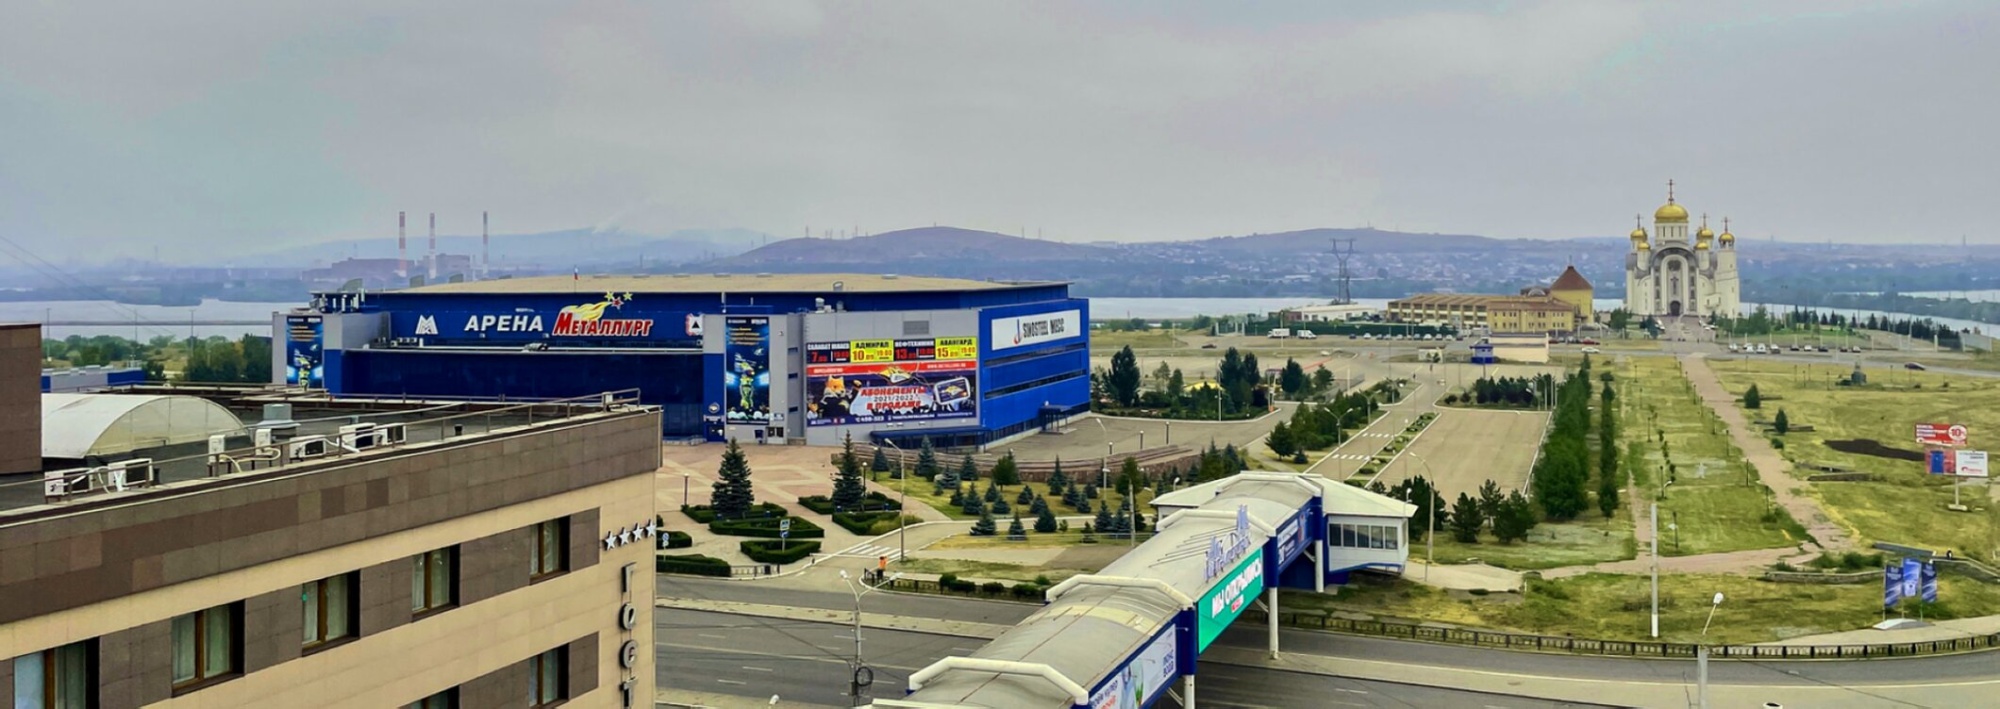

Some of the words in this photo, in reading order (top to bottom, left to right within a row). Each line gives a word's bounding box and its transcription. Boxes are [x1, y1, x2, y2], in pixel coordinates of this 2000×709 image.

[464, 314, 544, 332] АРЕНА
[552, 311, 654, 337] МЕТАЛЛУРГ
[855, 341, 890, 349] АДМИРАЛ
[940, 338, 973, 346] АВАНГАРД
[860, 386, 927, 397] АБОНЕМЕНТЫ
